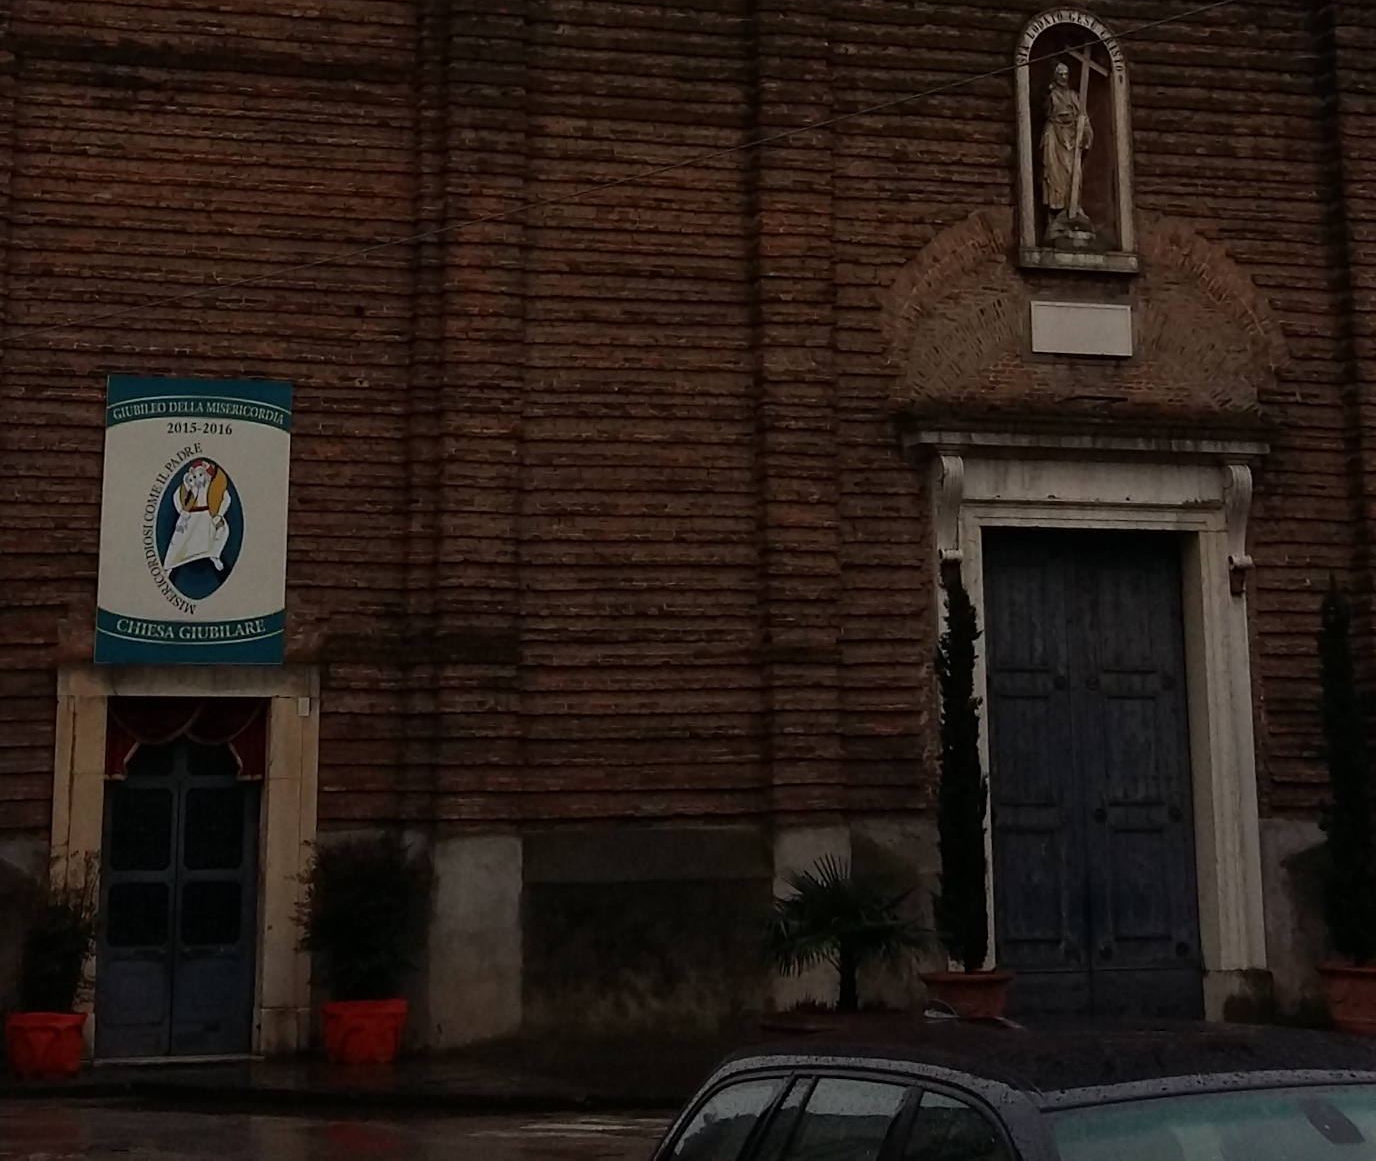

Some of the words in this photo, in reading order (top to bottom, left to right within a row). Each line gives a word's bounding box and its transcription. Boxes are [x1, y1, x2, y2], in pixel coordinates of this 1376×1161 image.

[112, 401, 167, 420] GIUBILEO
[168, 400, 204, 413] DELLA
[206, 401, 285, 426] MISERICORDIA
[166, 422, 233, 436] 2015-2016
[164, 442, 203, 473] PADRE
[156, 472, 171, 485] IL
[144, 485, 163, 522] COME
[142, 525, 197, 615] MISERICORDIOSI
[115, 618, 175, 639] CHIESA
[178, 618, 266, 640] GIUBILARE
